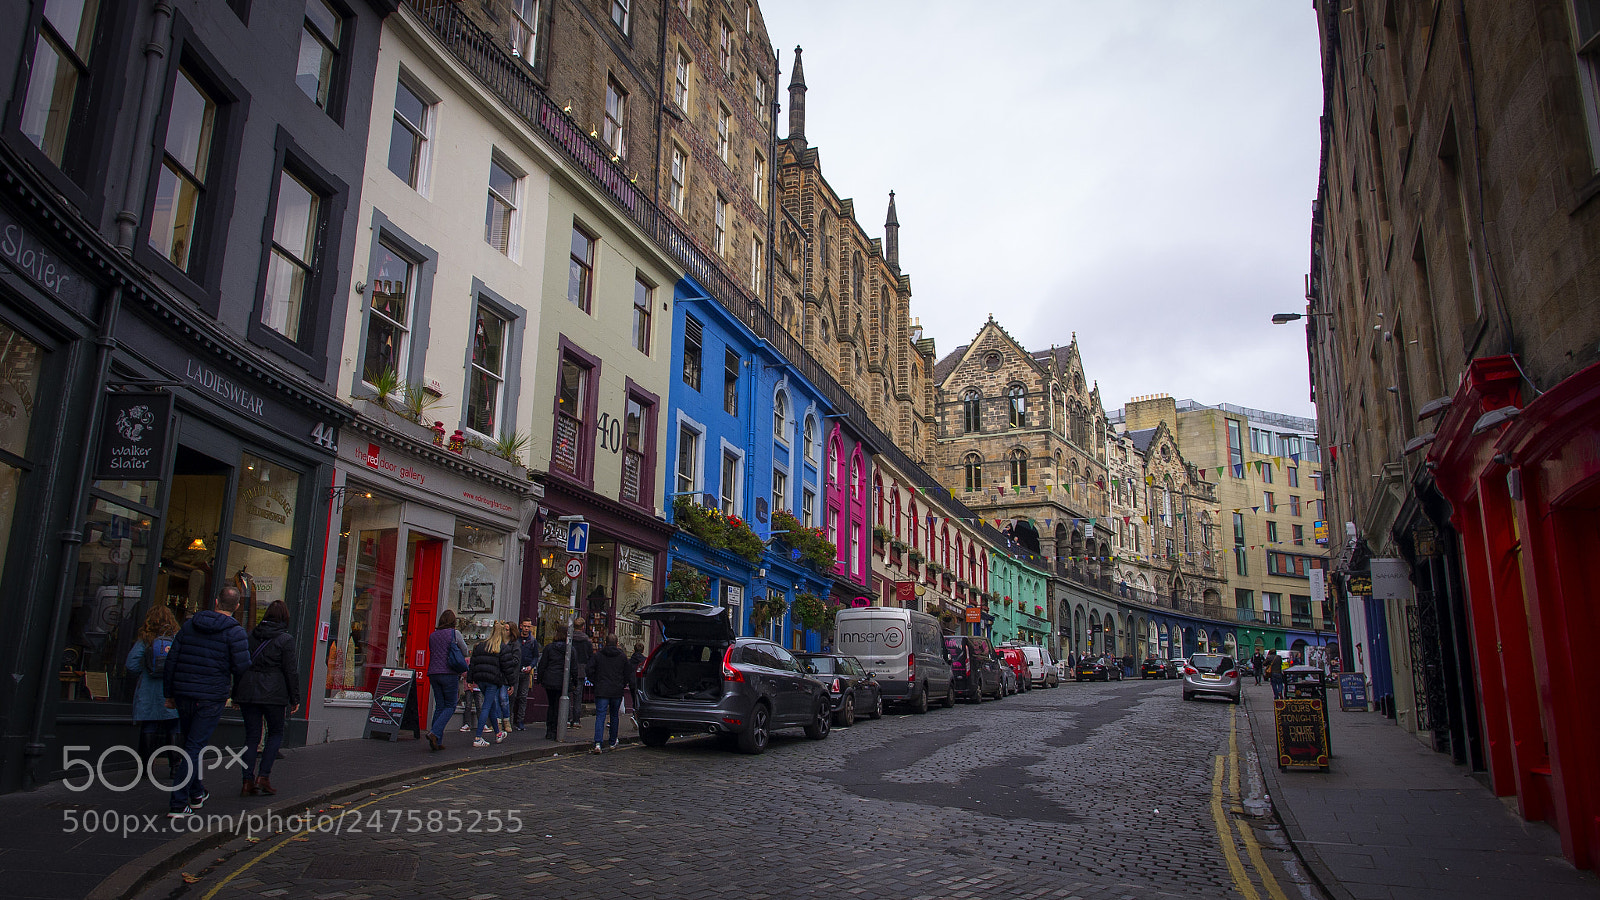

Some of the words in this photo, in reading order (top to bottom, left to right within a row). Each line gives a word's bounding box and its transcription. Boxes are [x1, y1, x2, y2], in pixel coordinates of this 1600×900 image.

[2, 224, 70, 293] Slater
[186, 358, 264, 417] LADIESWEAR
[597, 412, 620, 454] 40
[111, 445, 152, 456] walker
[355, 447, 367, 461] the
[367, 452, 379, 466] red
[379, 458, 398, 473] door
[399, 465, 426, 485] gallery
[568, 564, 581, 573] 20
[840, 632, 899, 643] innserve
[1287, 704, 1311, 713] TOURS
